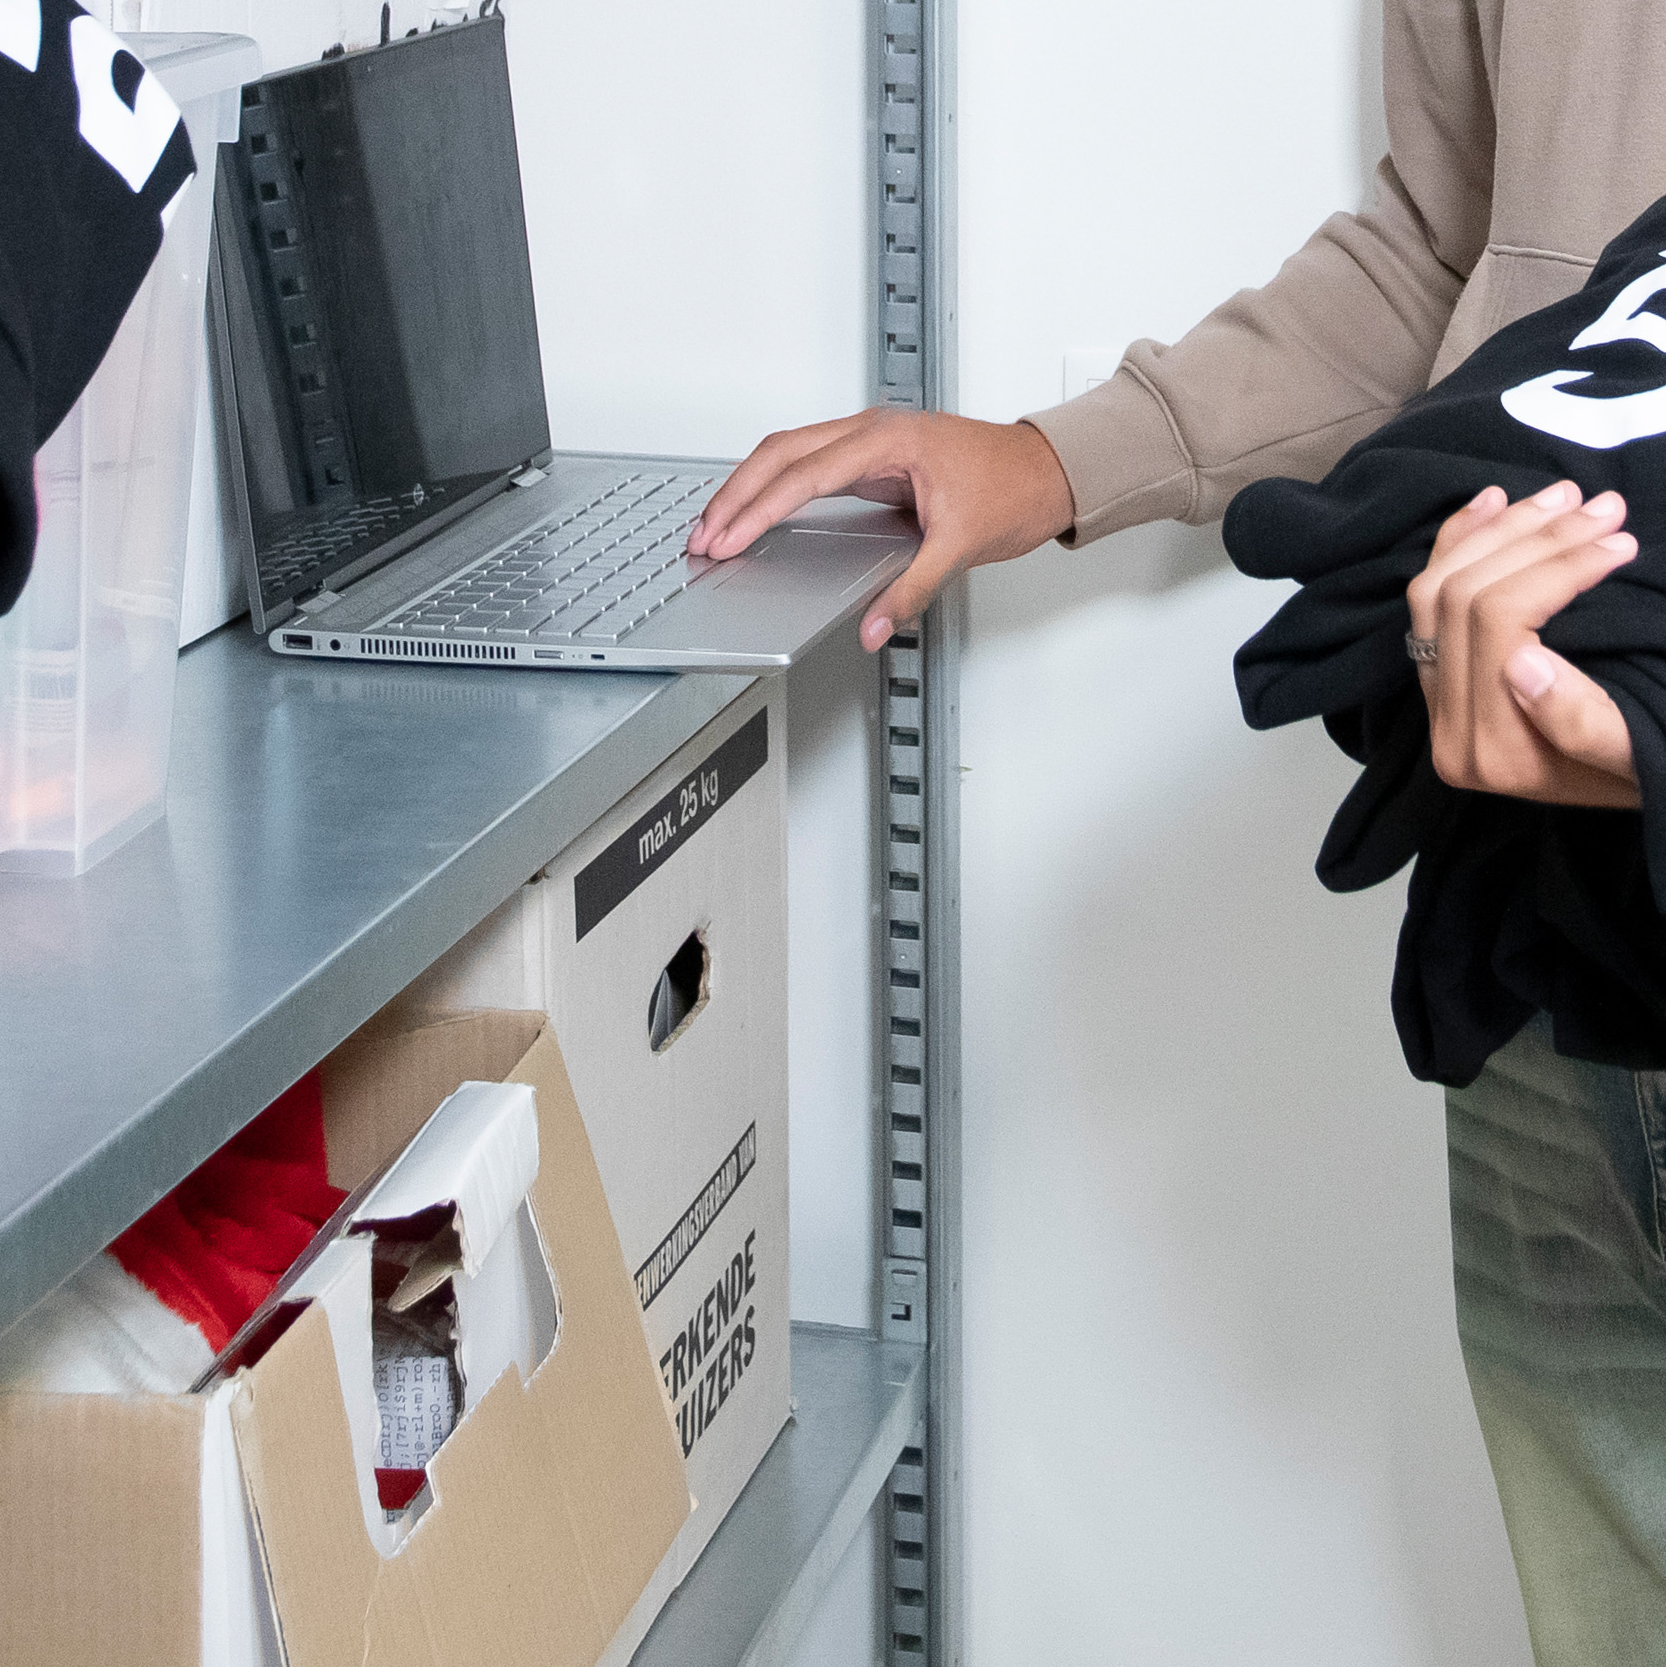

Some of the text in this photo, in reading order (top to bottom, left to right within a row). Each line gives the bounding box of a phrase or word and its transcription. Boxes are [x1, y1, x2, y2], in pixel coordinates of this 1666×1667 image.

[638, 768, 719, 865] max. 25 kg
